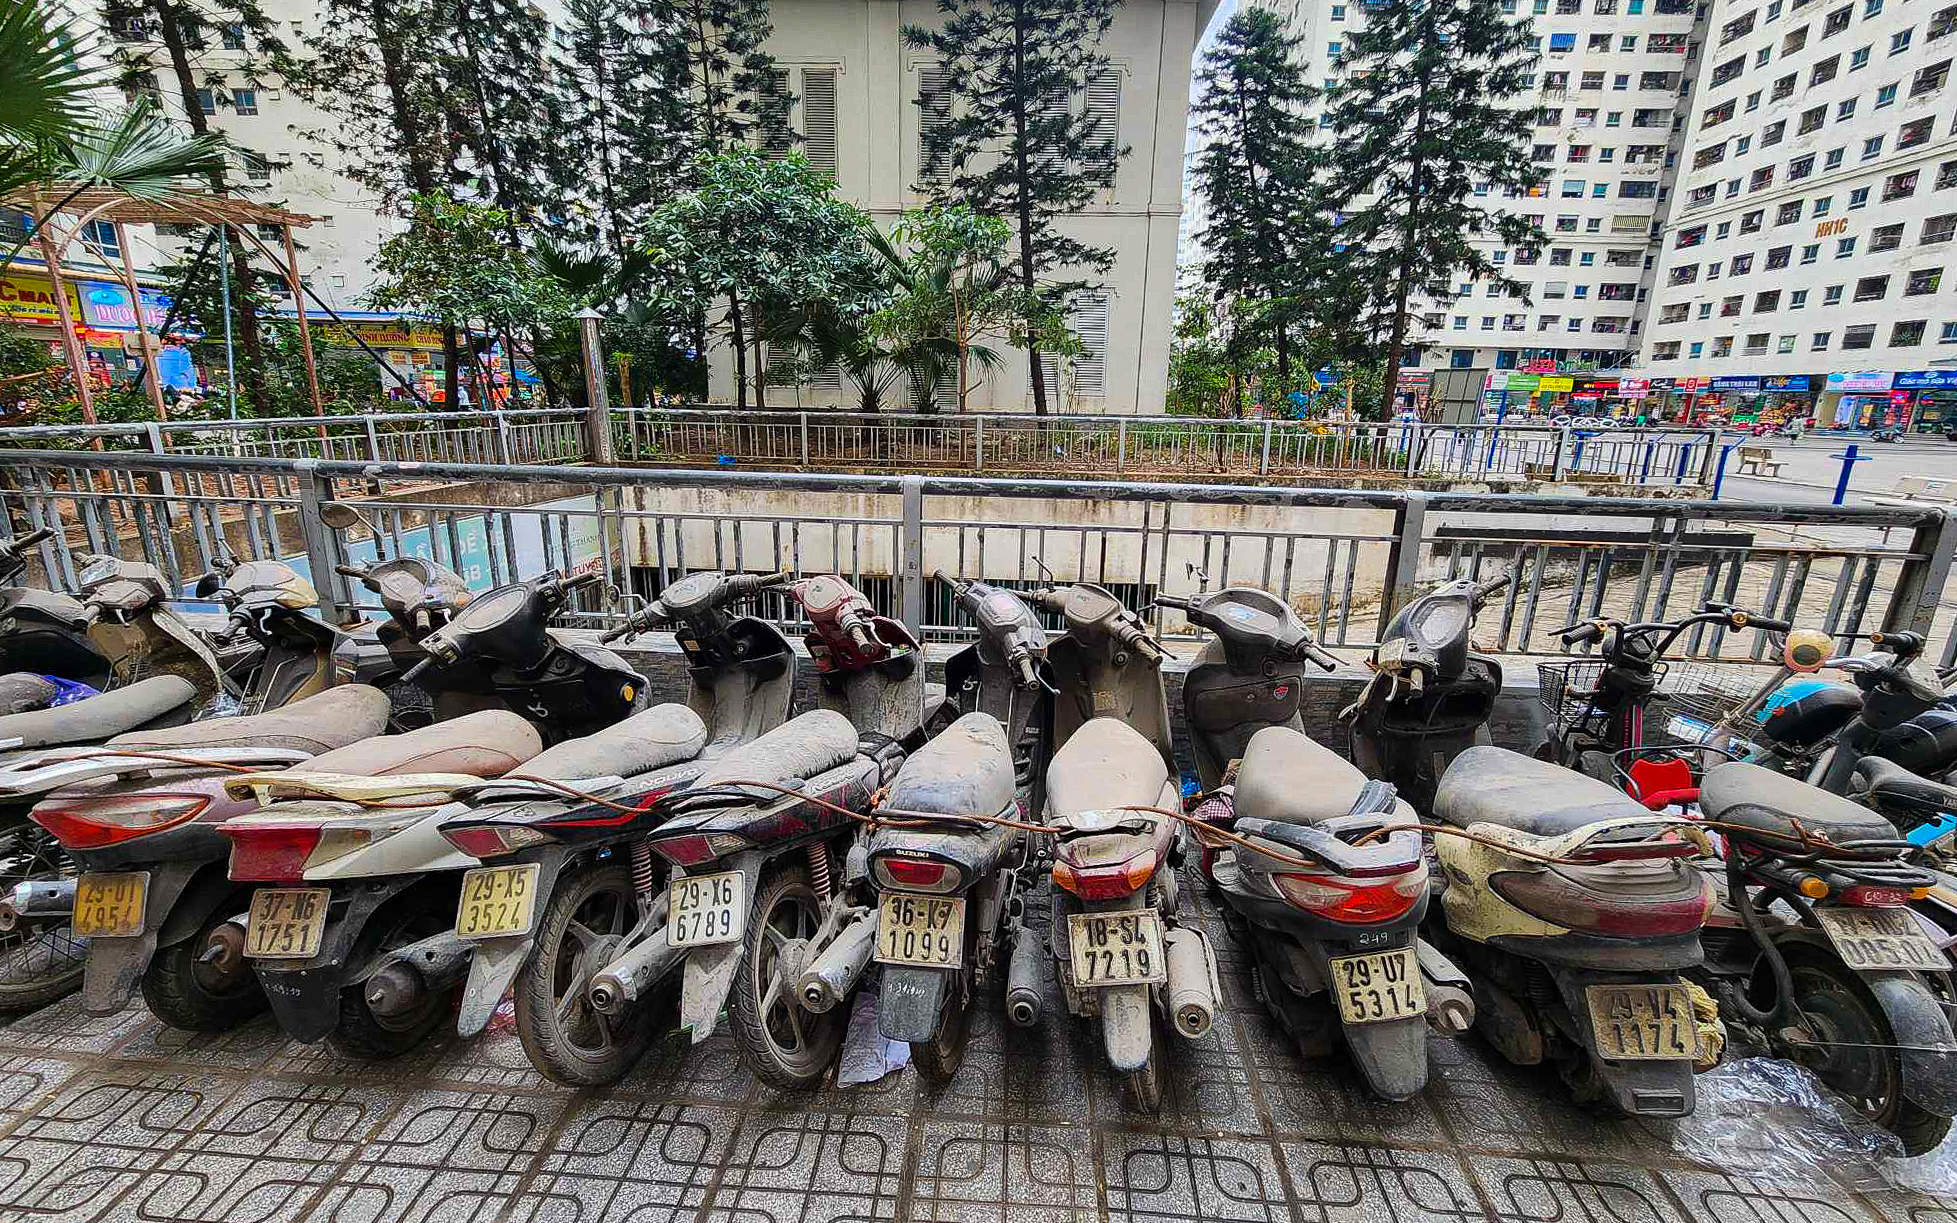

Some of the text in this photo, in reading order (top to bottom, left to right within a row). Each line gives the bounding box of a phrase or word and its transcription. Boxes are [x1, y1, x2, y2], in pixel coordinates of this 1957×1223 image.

[896, 850, 930, 859] SUZUKI
[472, 871, 527, 901] 29-X5
[679, 878, 732, 911] 29-X6
[262, 892, 318, 921] 37-N6
[467, 901, 521, 932] 3524
[890, 896, 953, 930] 36-K7
[257, 923, 310, 953] 1751
[676, 908, 731, 942] 6789
[889, 930, 950, 961] 1099
[1084, 948, 1151, 981] 7219
[1342, 953, 1405, 988] 29-U7
[1349, 984, 1417, 1020] 5314
[1611, 1022, 1685, 1055] 1174
